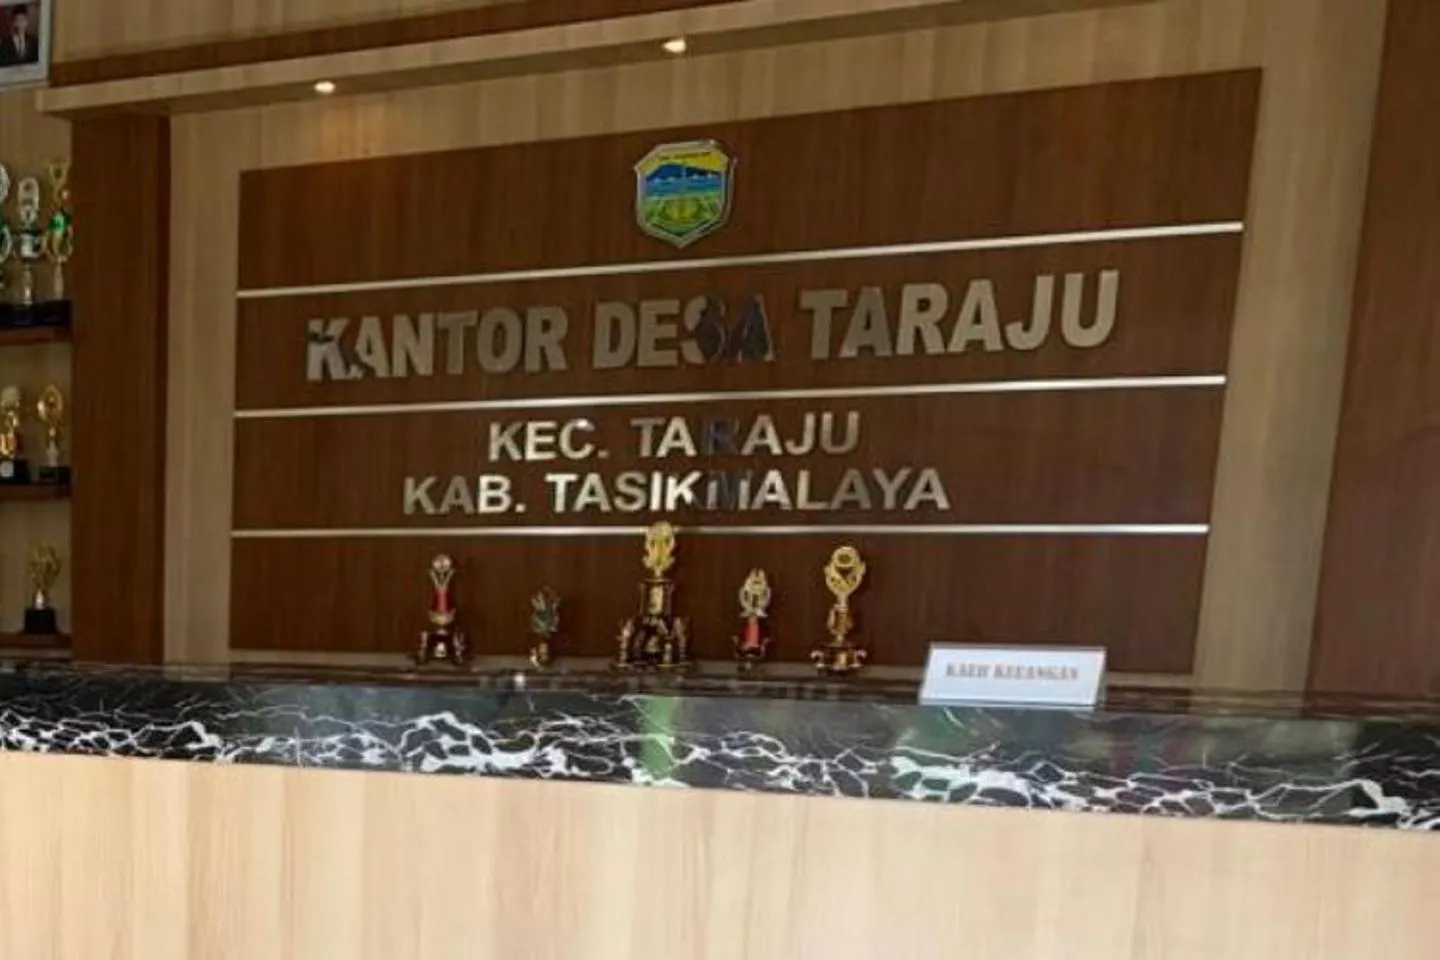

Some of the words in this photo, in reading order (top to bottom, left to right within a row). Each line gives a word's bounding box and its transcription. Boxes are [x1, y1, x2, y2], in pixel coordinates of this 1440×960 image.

[306, 306, 569, 382] KANTOR
[593, 291, 776, 369] DESA
[800, 269, 1120, 361] TARAJU
[487, 418, 610, 462] KEC.
[630, 410, 861, 460] TARAJU
[402, 474, 526, 515] KAB.
[545, 466, 952, 514] TASIKMALAYA
